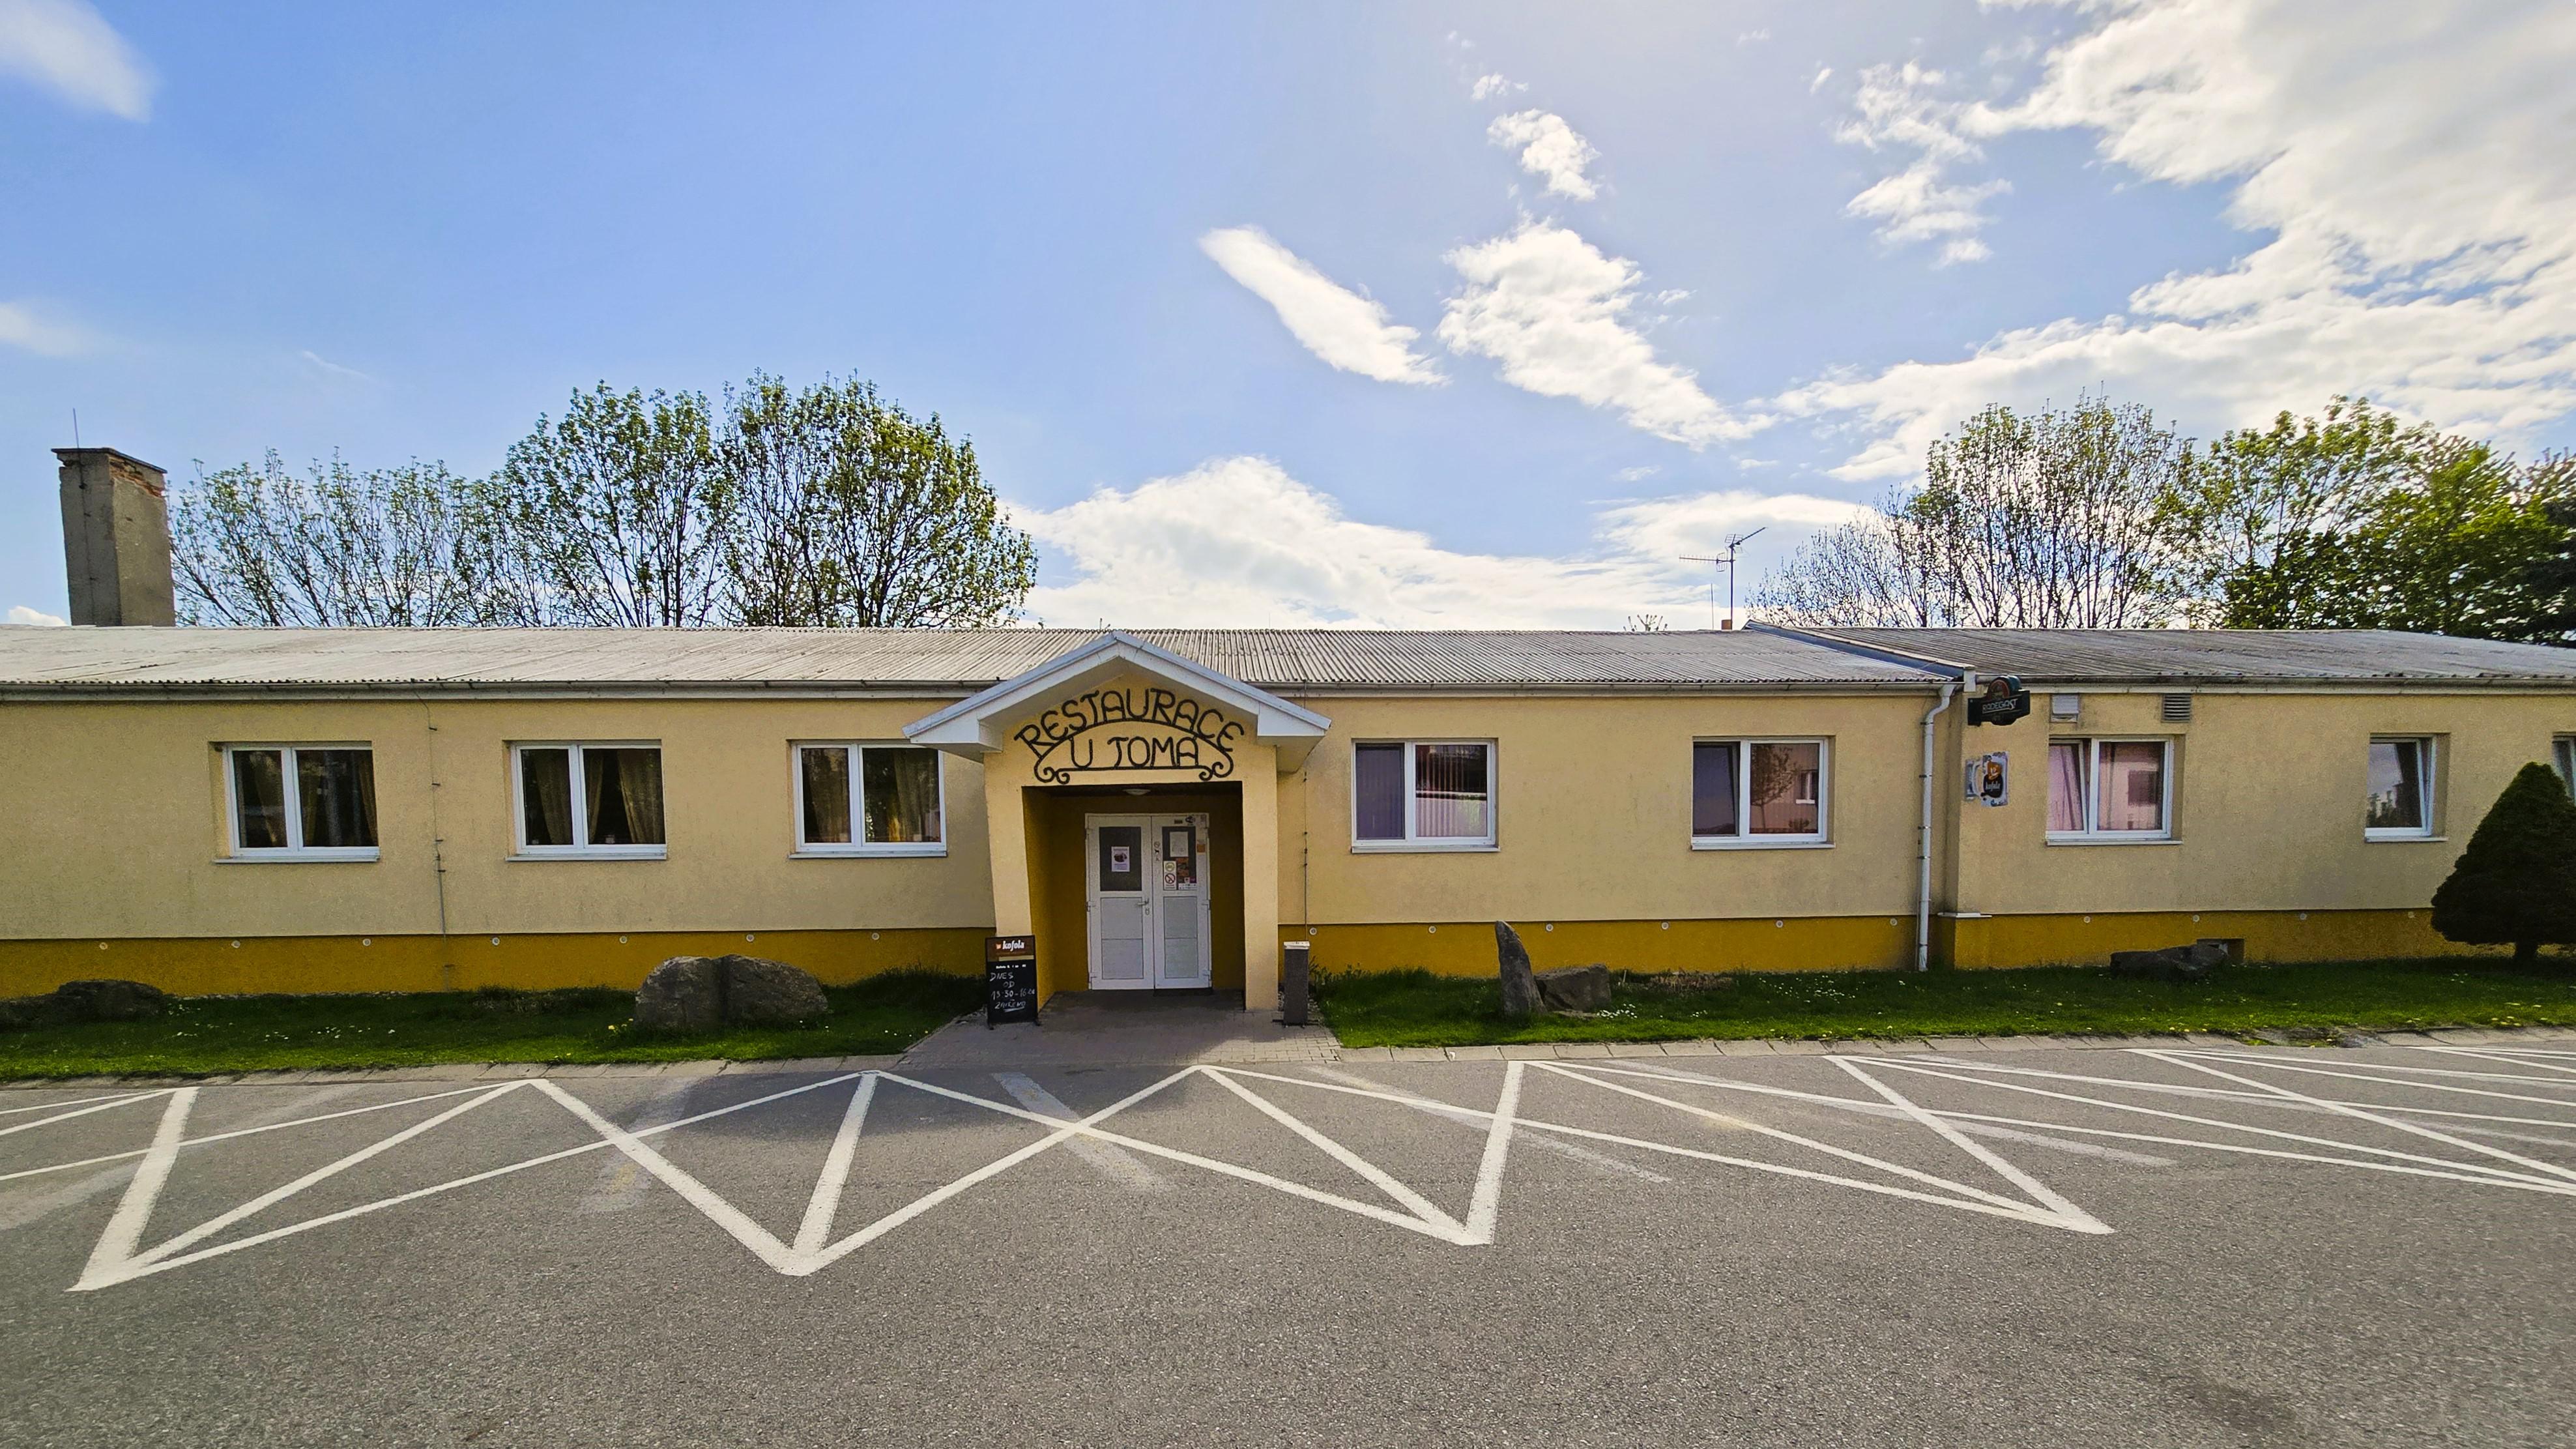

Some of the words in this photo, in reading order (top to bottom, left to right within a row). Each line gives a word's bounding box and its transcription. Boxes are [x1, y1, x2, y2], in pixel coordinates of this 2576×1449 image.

[1014, 688, 1244, 758] RESTAURACE
[1069, 737, 1093, 769] U
[1108, 737, 1198, 768] TOMA
[1002, 940, 1025, 952] kofola
[989, 972, 1014, 982] DNES
